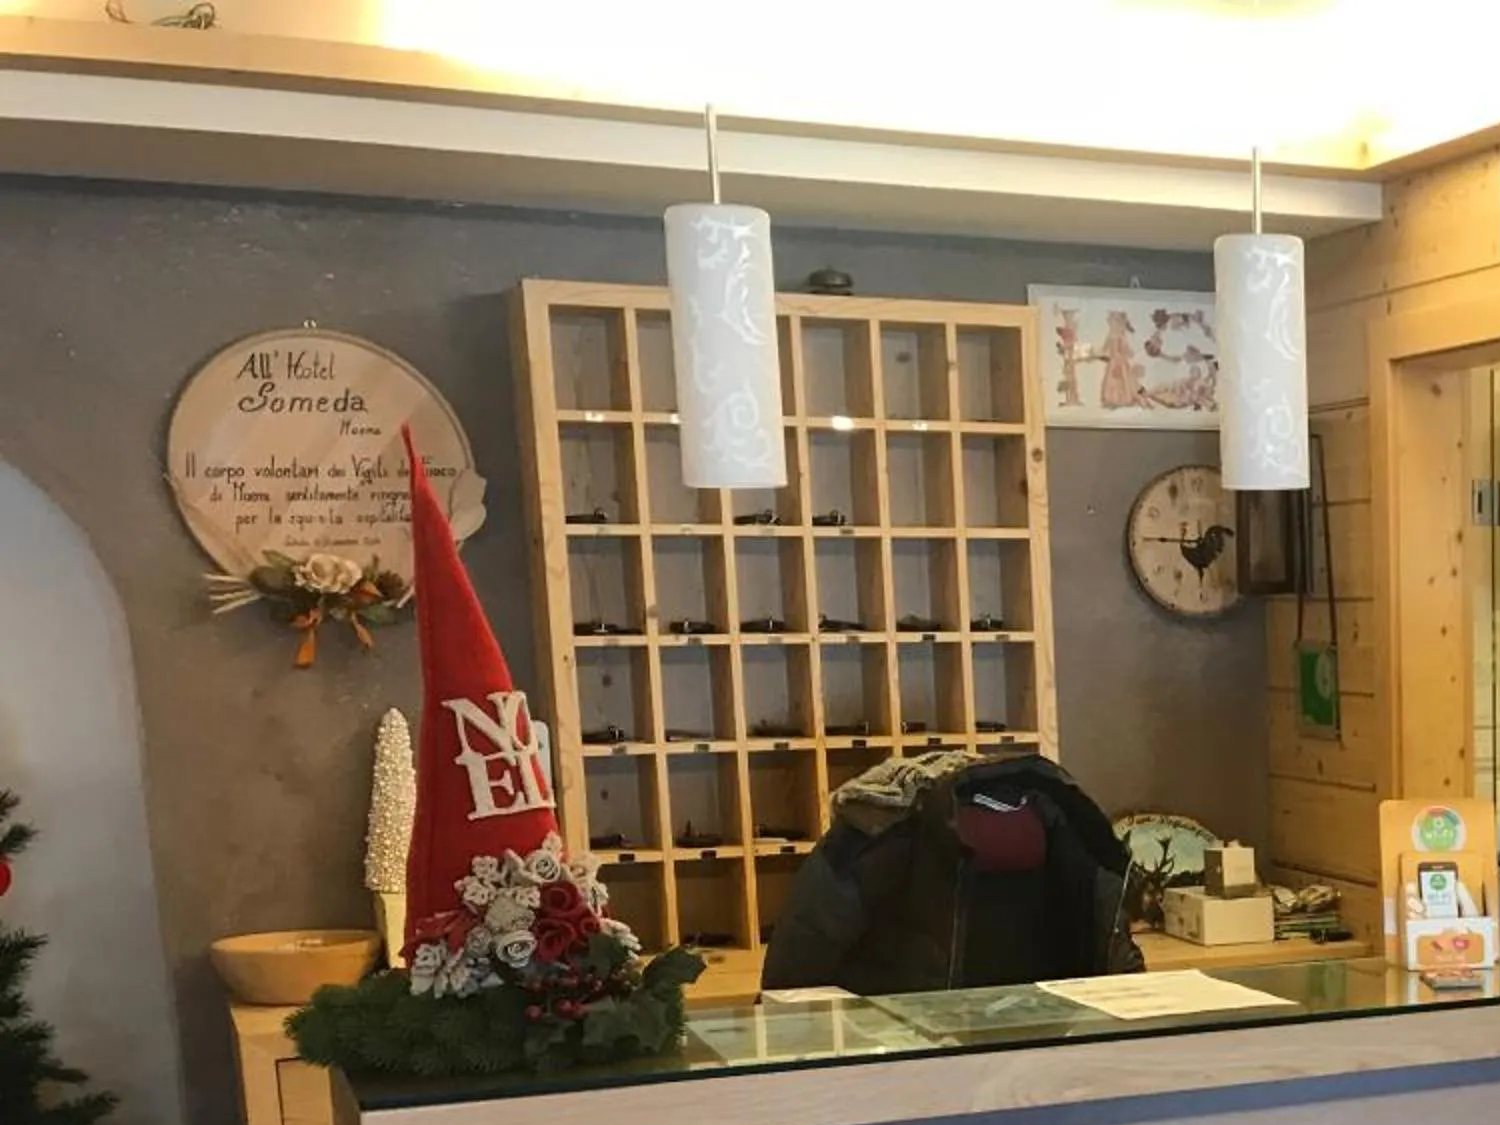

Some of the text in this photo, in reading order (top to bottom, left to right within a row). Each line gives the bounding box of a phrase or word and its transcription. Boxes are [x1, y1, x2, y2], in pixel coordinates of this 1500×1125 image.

[286, 351, 335, 380] Hotel
[237, 381, 368, 413] Someda
[204, 466, 245, 484] corpo
